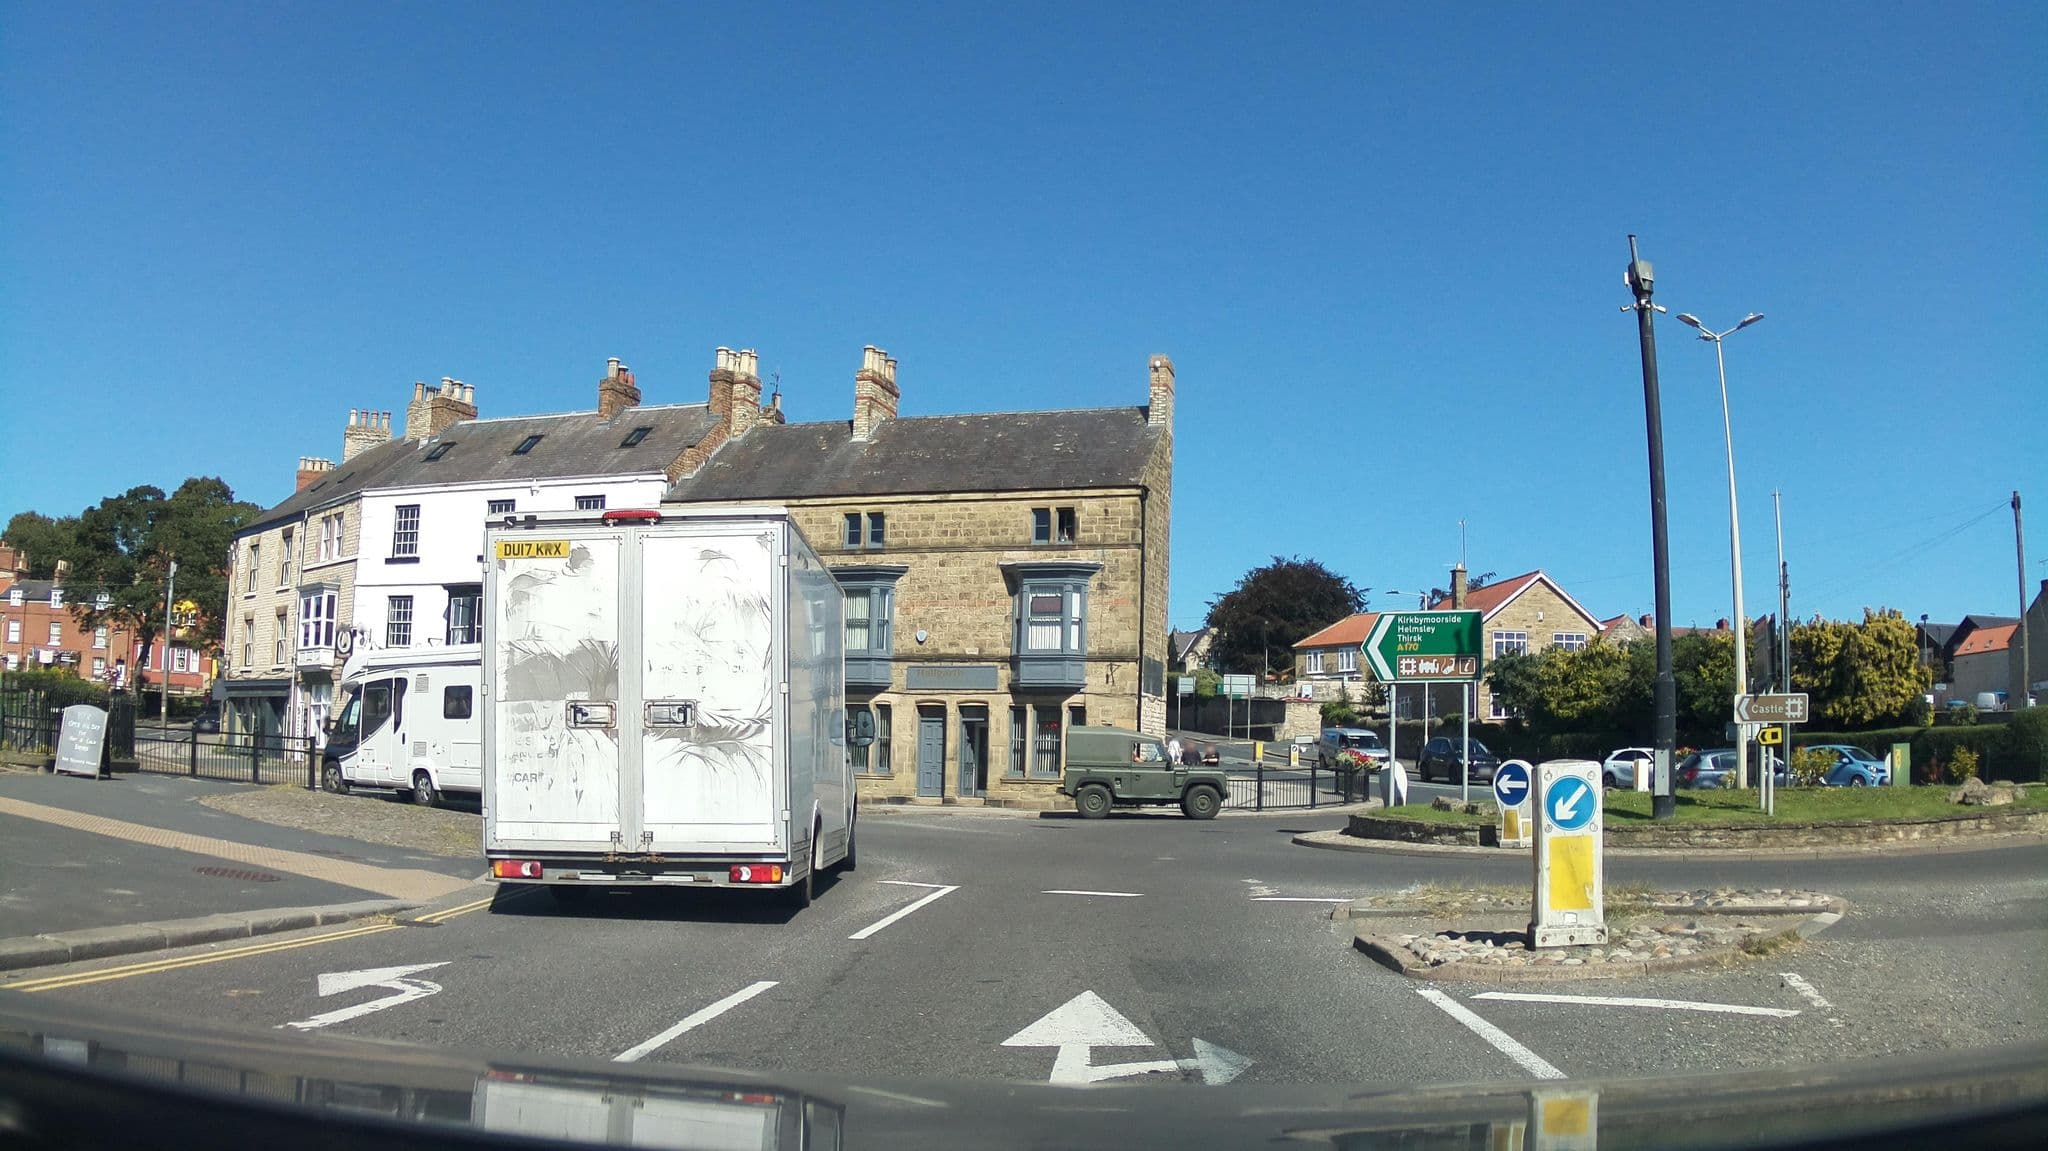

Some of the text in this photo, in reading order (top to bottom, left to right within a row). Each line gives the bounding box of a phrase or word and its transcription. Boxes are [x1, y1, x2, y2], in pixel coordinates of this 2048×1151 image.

[504, 543, 532, 557] DU17
[1397, 615, 1462, 625] Kirkbymoorside
[1397, 625, 1436, 634] Helmsley
[1397, 634, 1423, 642] Thirsk
[1397, 643, 1419, 651] A170
[1751, 704, 1784, 714] Castle
